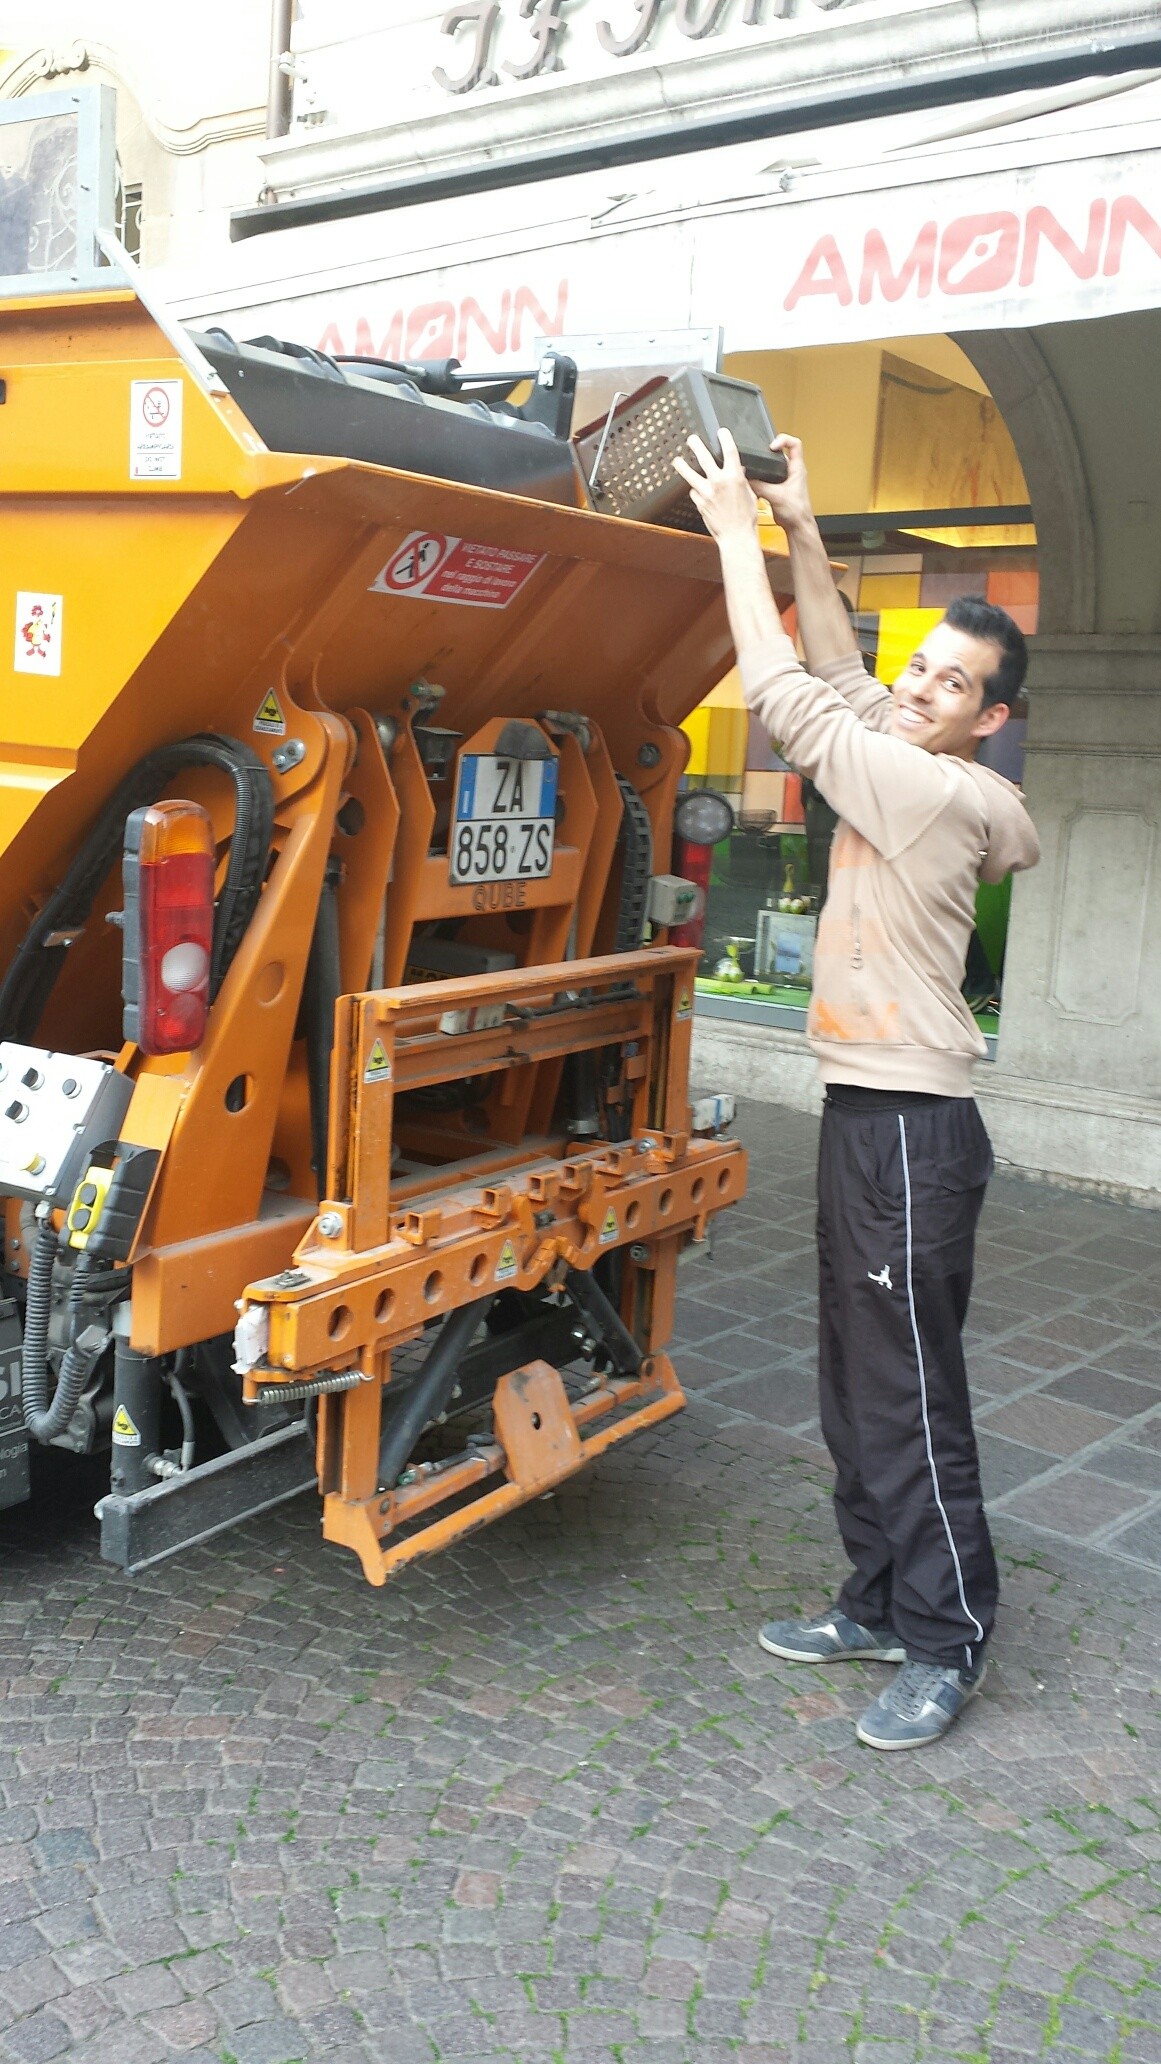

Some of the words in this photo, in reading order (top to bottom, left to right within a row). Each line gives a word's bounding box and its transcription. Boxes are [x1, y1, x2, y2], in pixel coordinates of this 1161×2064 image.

[492, 760, 525, 813] ZA
[457, 825, 508, 877] 858
[518, 823, 550, 874] ZS
[473, 882, 526, 911] QUBE
